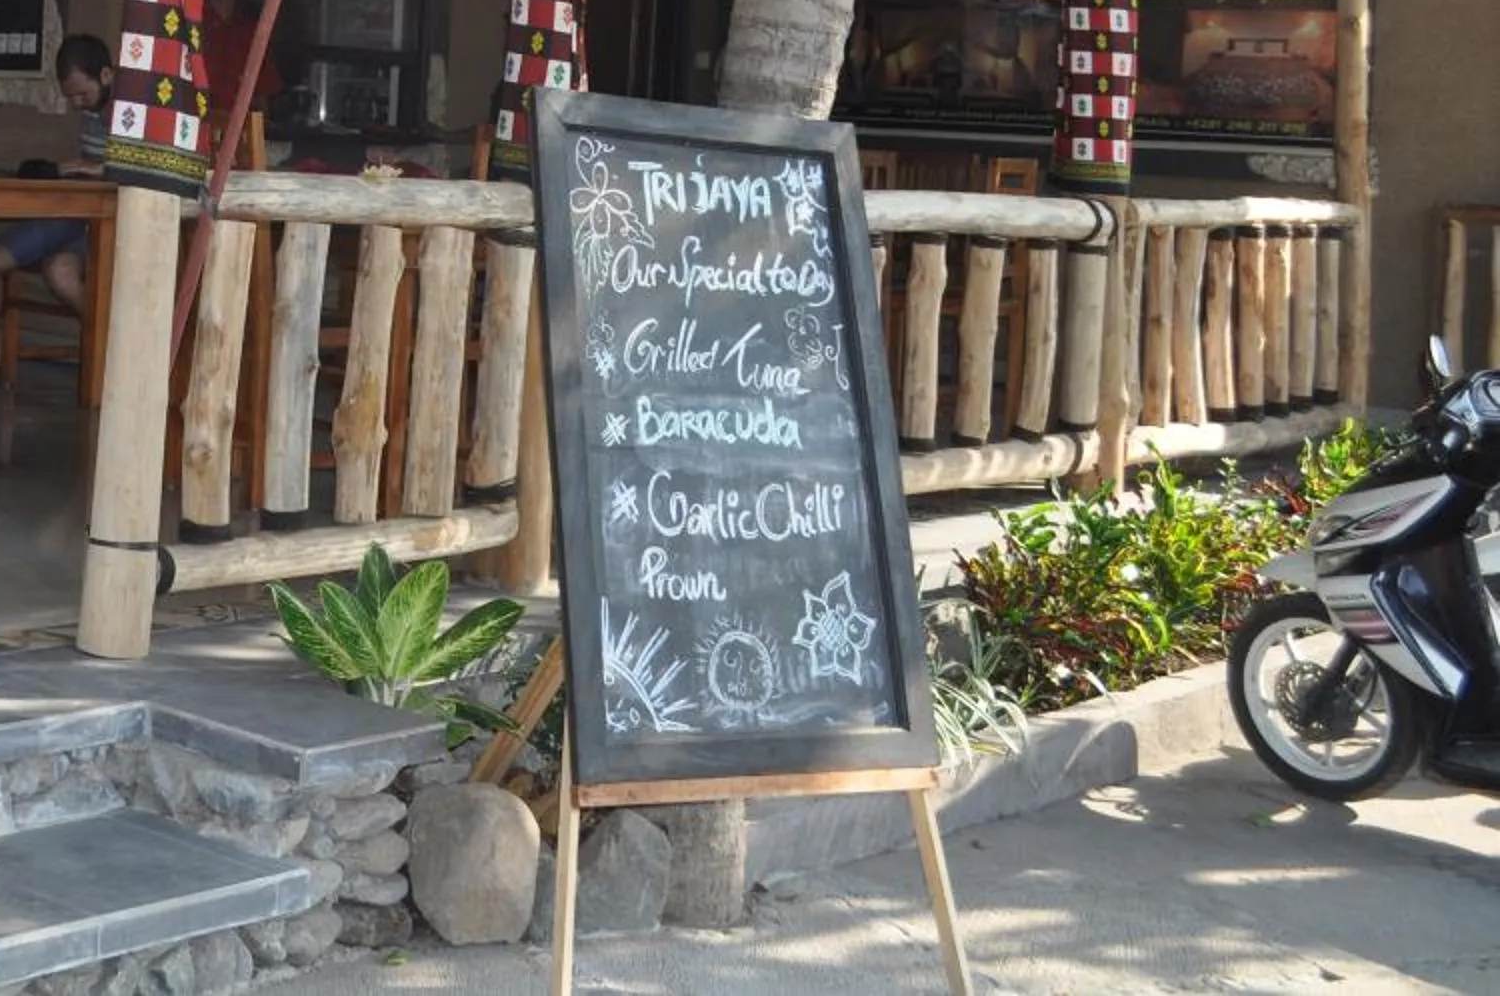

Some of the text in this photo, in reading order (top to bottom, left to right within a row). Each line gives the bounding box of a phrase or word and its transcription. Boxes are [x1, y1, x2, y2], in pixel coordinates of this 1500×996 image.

[624, 318, 811, 395] Grilled Tuna
[648, 470, 844, 544] Garlic Chilli
